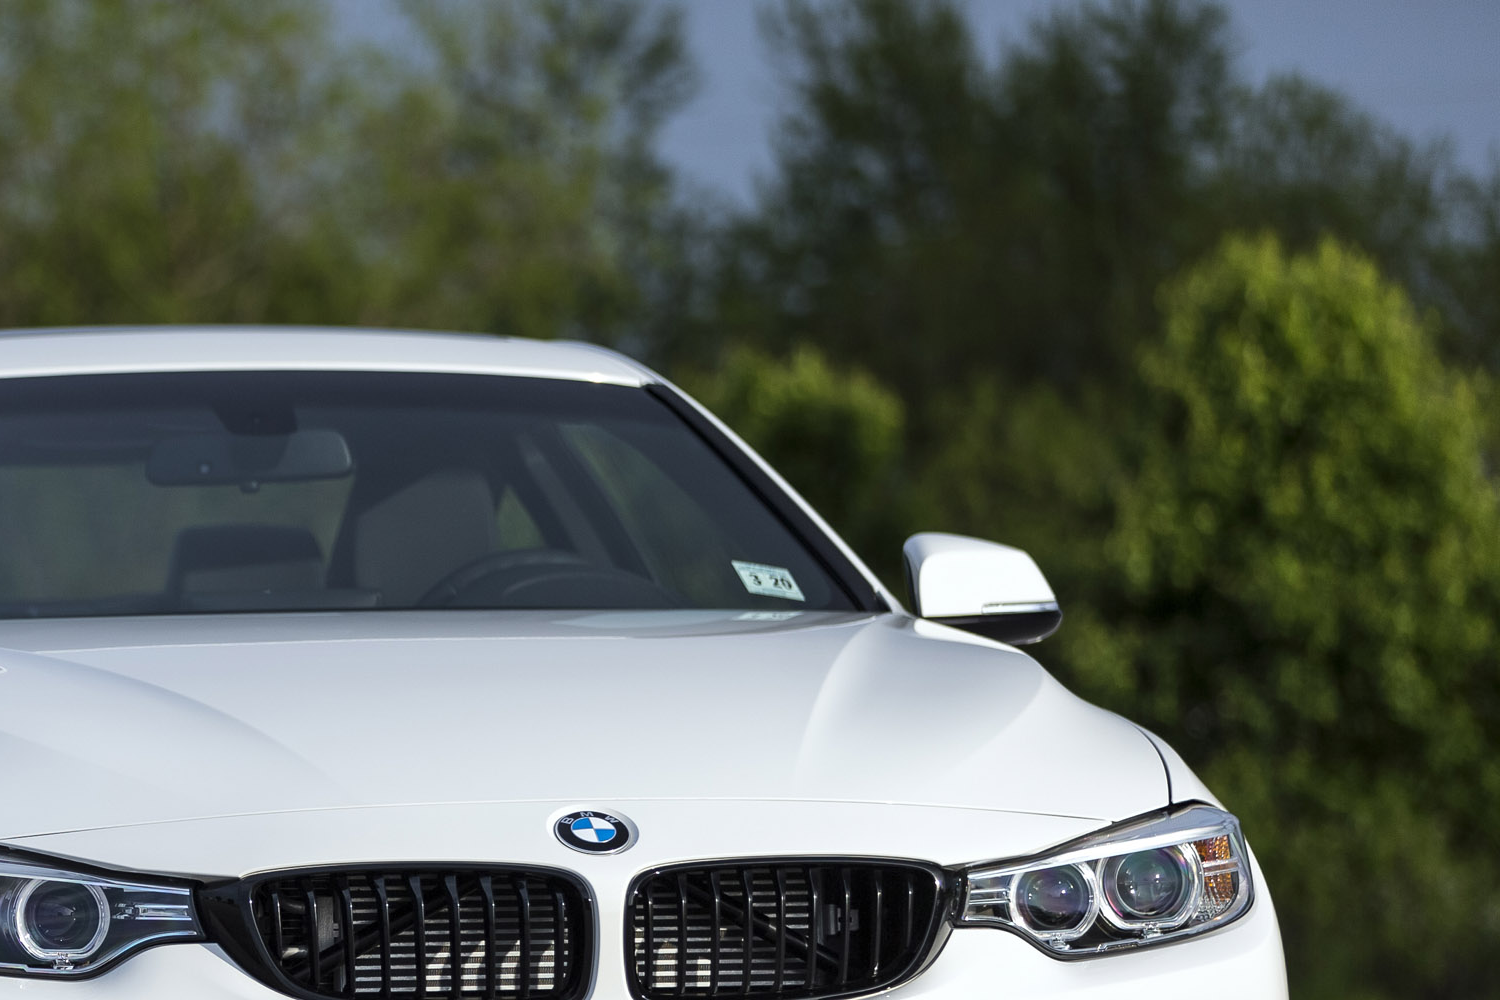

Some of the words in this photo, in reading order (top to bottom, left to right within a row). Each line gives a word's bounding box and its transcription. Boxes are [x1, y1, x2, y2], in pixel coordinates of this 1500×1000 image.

[748, 571, 762, 586] 3
[769, 575, 793, 591] 20
[561, 811, 619, 825] BMW
